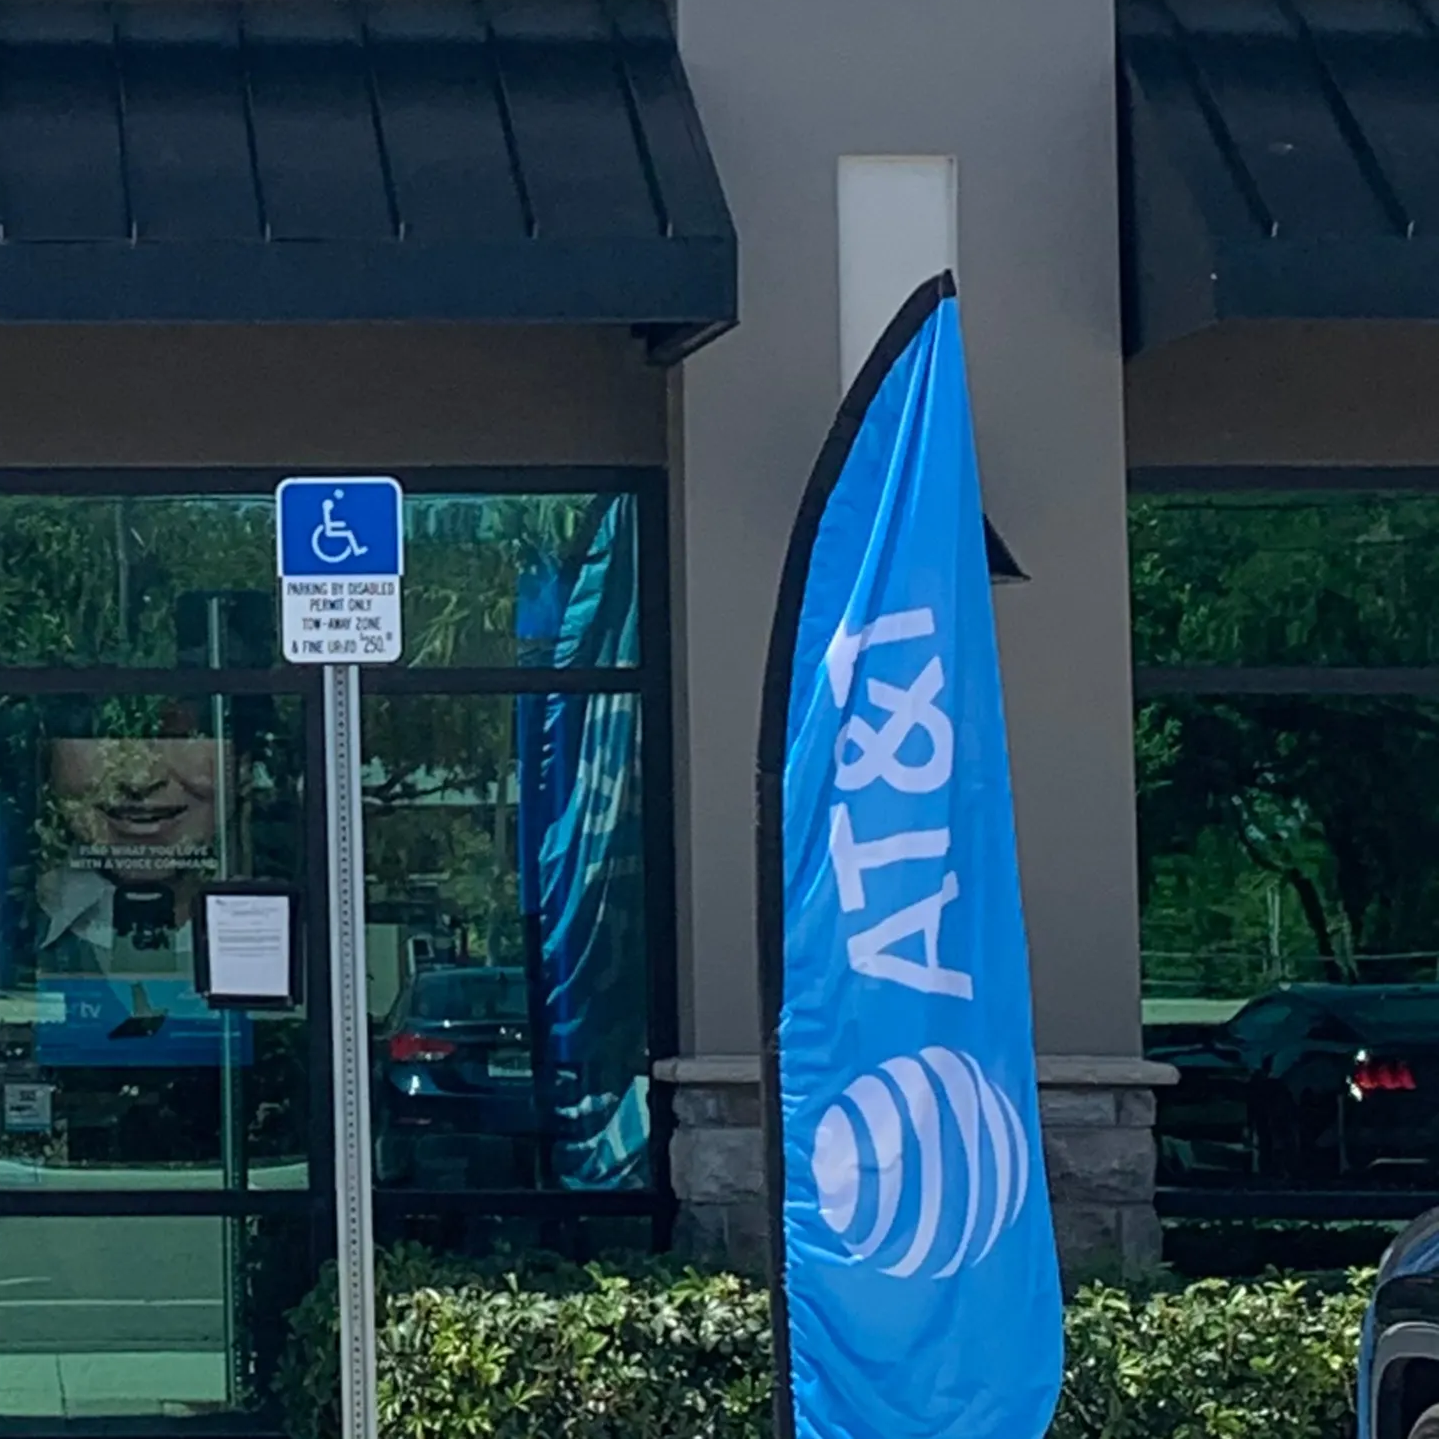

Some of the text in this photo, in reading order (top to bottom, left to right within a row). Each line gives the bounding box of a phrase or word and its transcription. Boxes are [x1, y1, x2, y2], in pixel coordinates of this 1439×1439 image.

[287, 582, 328, 595] PARKING
[331, 582, 344, 595] BY
[348, 598, 372, 612] ONLY
[356, 617, 381, 631] ZONE
[826, 607, 974, 1000] AT&T
